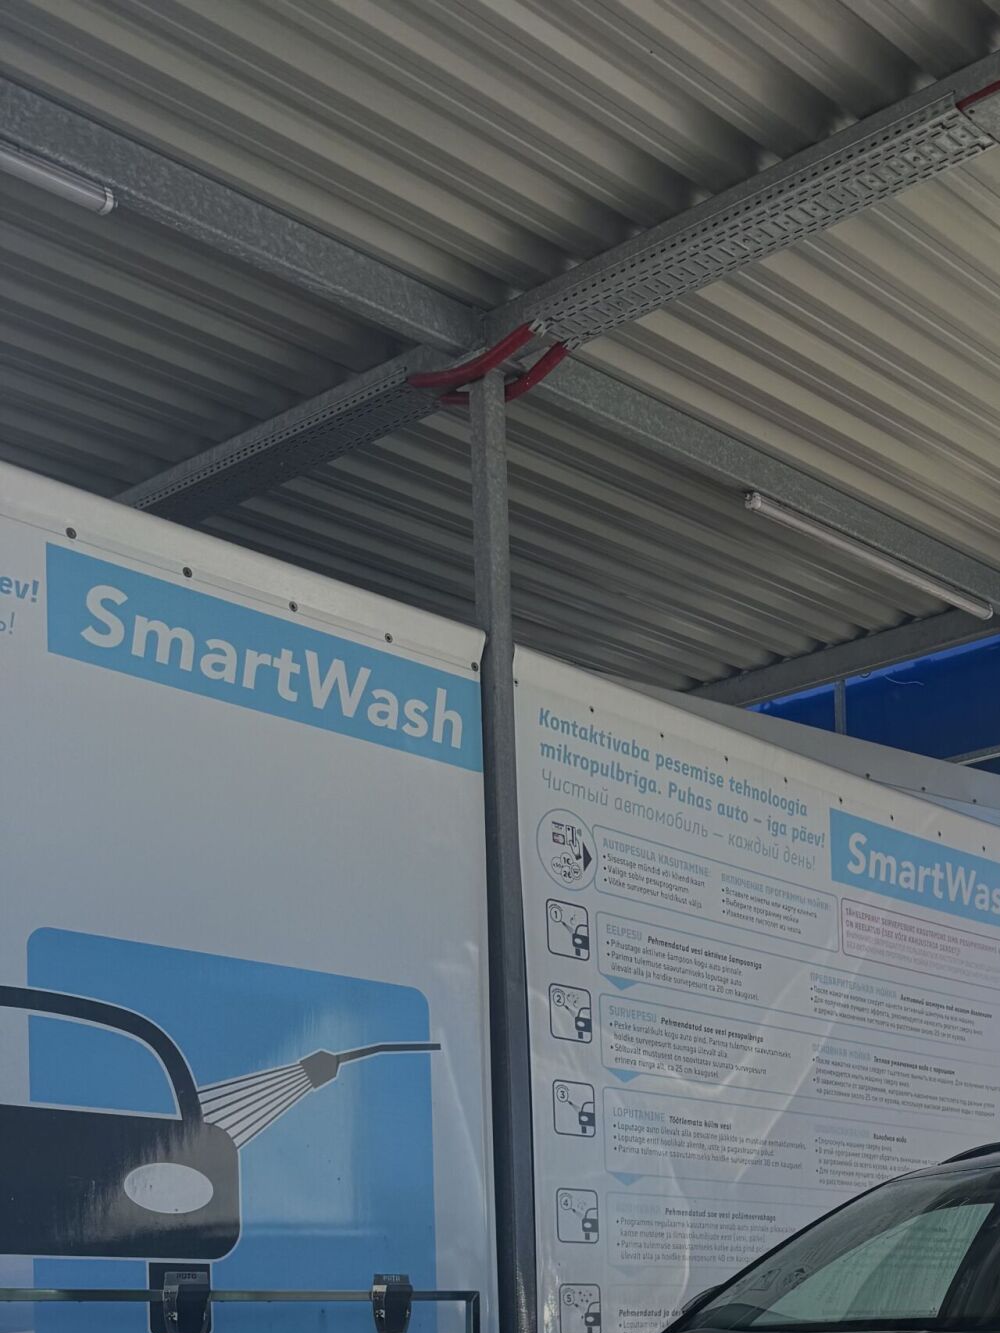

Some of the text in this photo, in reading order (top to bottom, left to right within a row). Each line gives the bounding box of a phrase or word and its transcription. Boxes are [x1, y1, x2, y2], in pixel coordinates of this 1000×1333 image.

[80, 585, 463, 749] SmartWash
[539, 707, 807, 817] Kontaktivaba pesemise tehnoloogia
[540, 741, 825, 848] mikropulbriga. Puhas auto iga päev!
[542, 768, 816, 871] Чистый автомобиль каждый день!
[603, 837, 655, 861] AUTOPESULA
[606, 924, 642, 941] EELPESU
[609, 1005, 657, 1023] SURVEPESU
[613, 1107, 664, 1122] LOPUTAMINE
